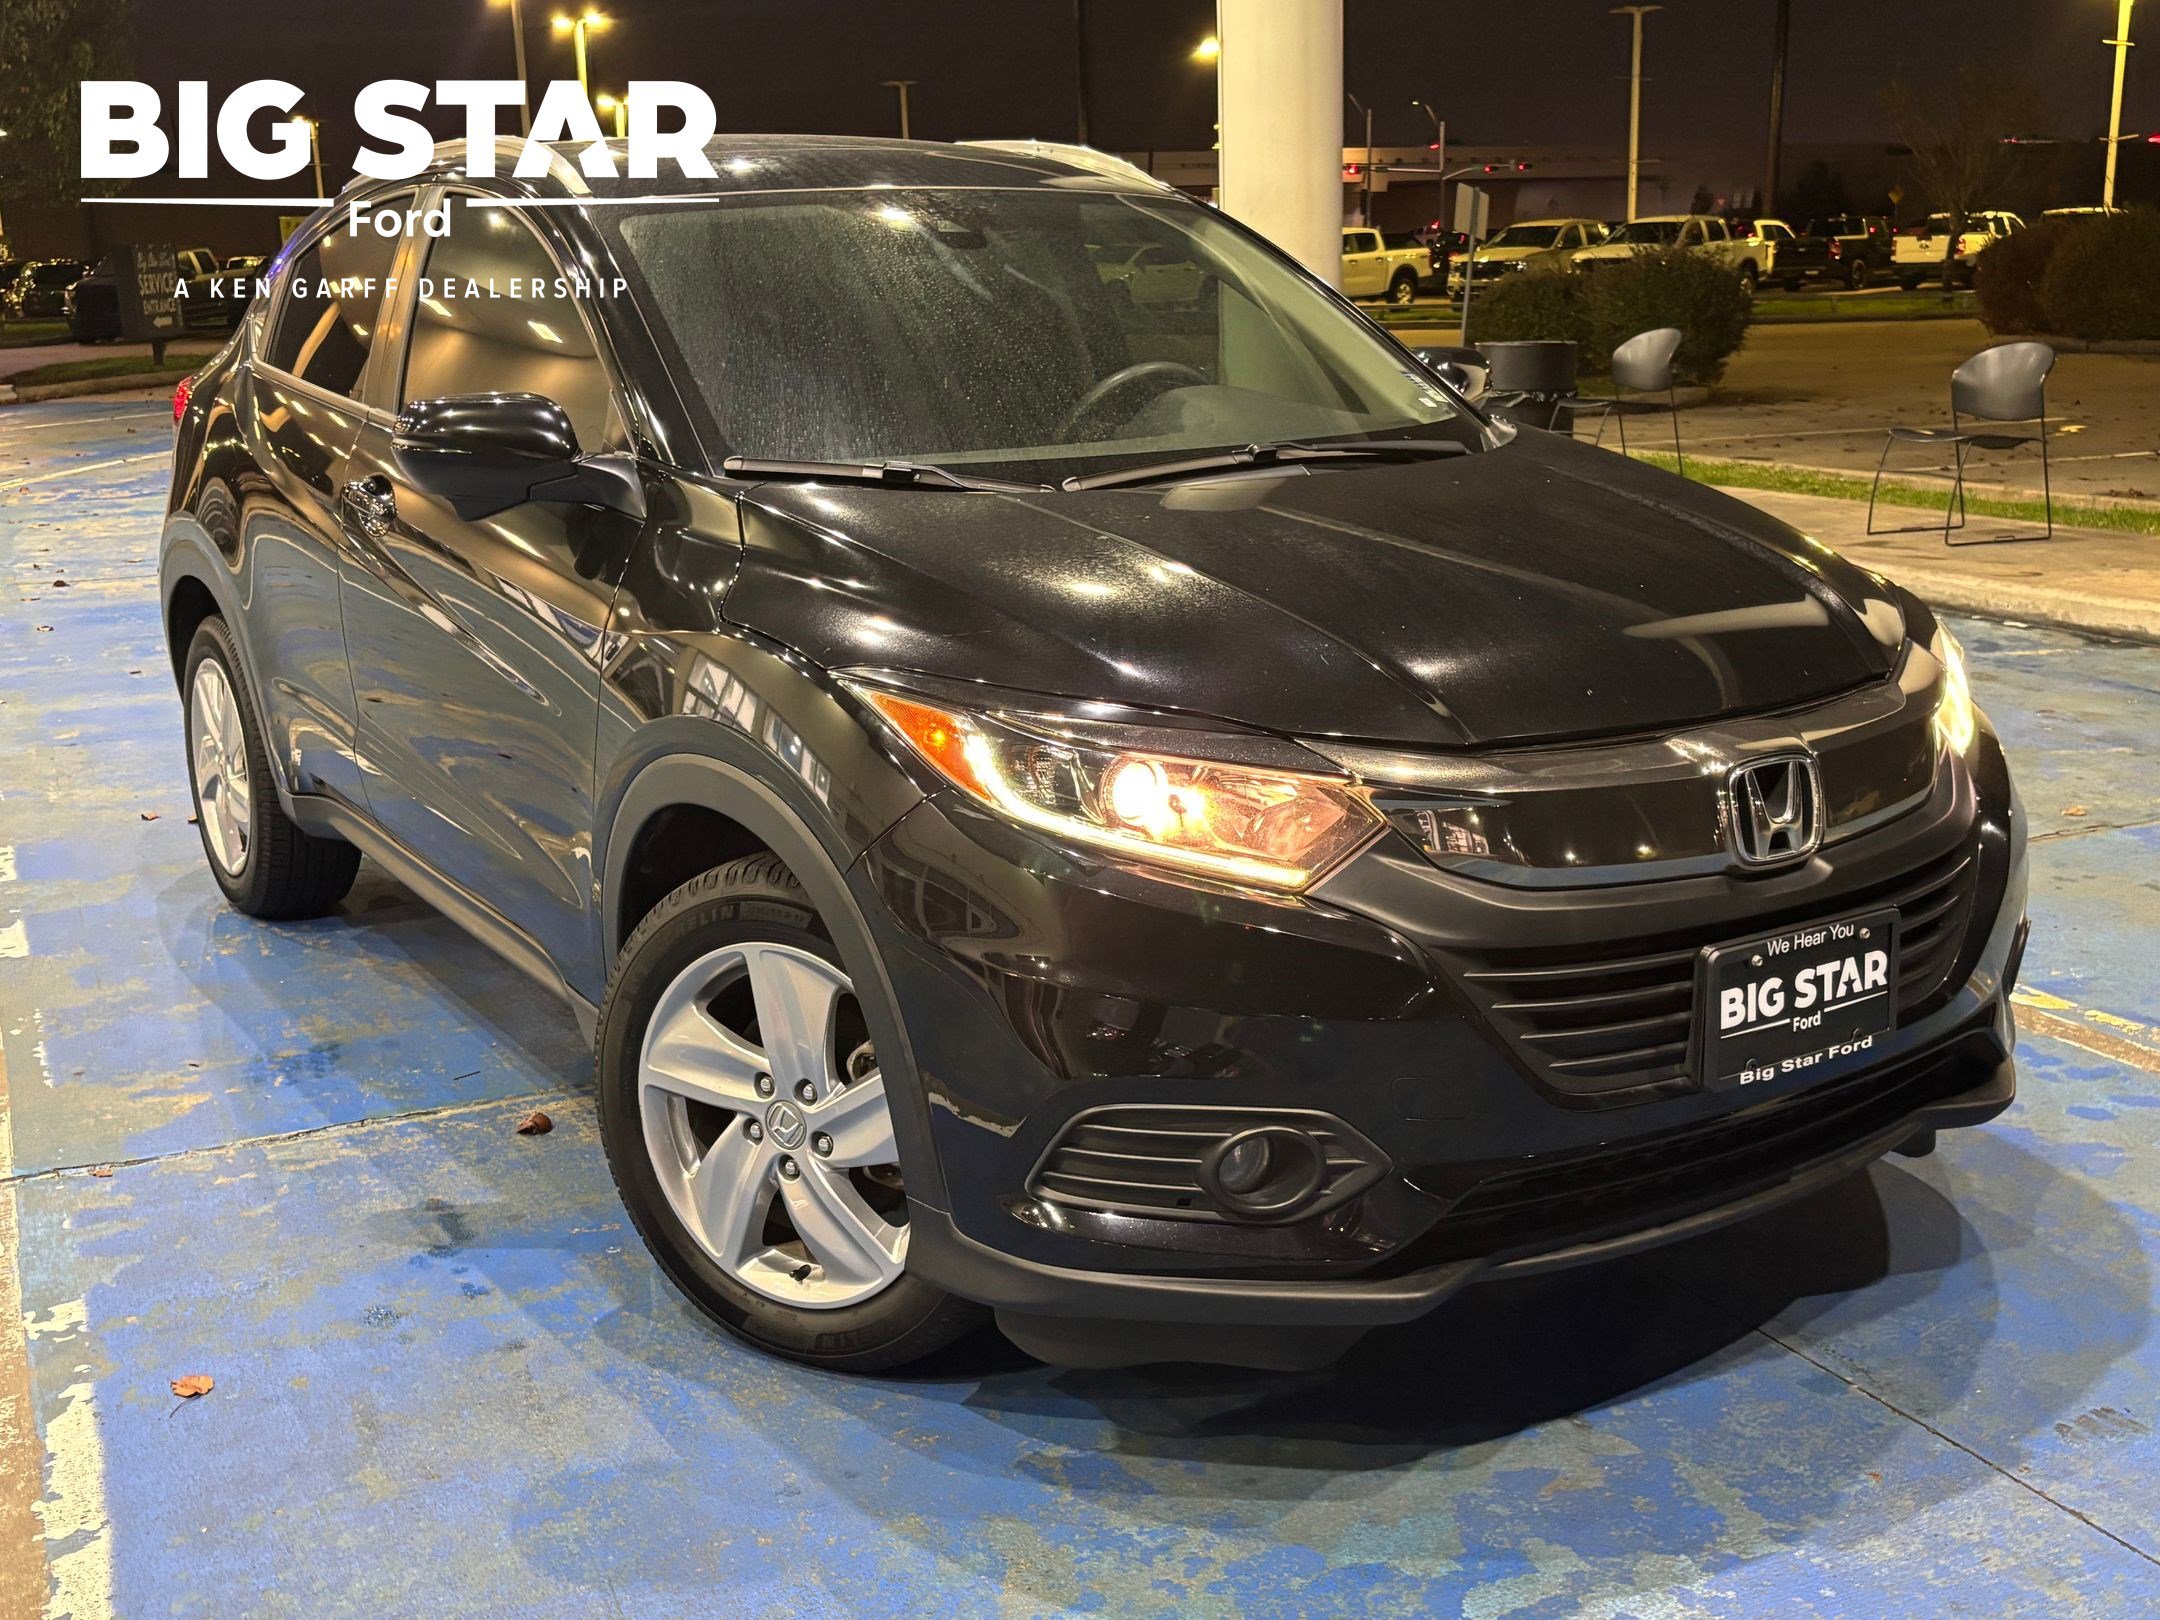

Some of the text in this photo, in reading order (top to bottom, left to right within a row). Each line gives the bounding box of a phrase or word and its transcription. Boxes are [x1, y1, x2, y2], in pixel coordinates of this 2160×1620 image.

[138, 272, 176, 296] SERVICE
[1767, 924, 1855, 957] We Hear You
[1720, 949, 1888, 1031] BIG STAR
[1793, 1010, 1822, 1032] Ford
[1740, 1035, 1873, 1086] Big Star Ford
